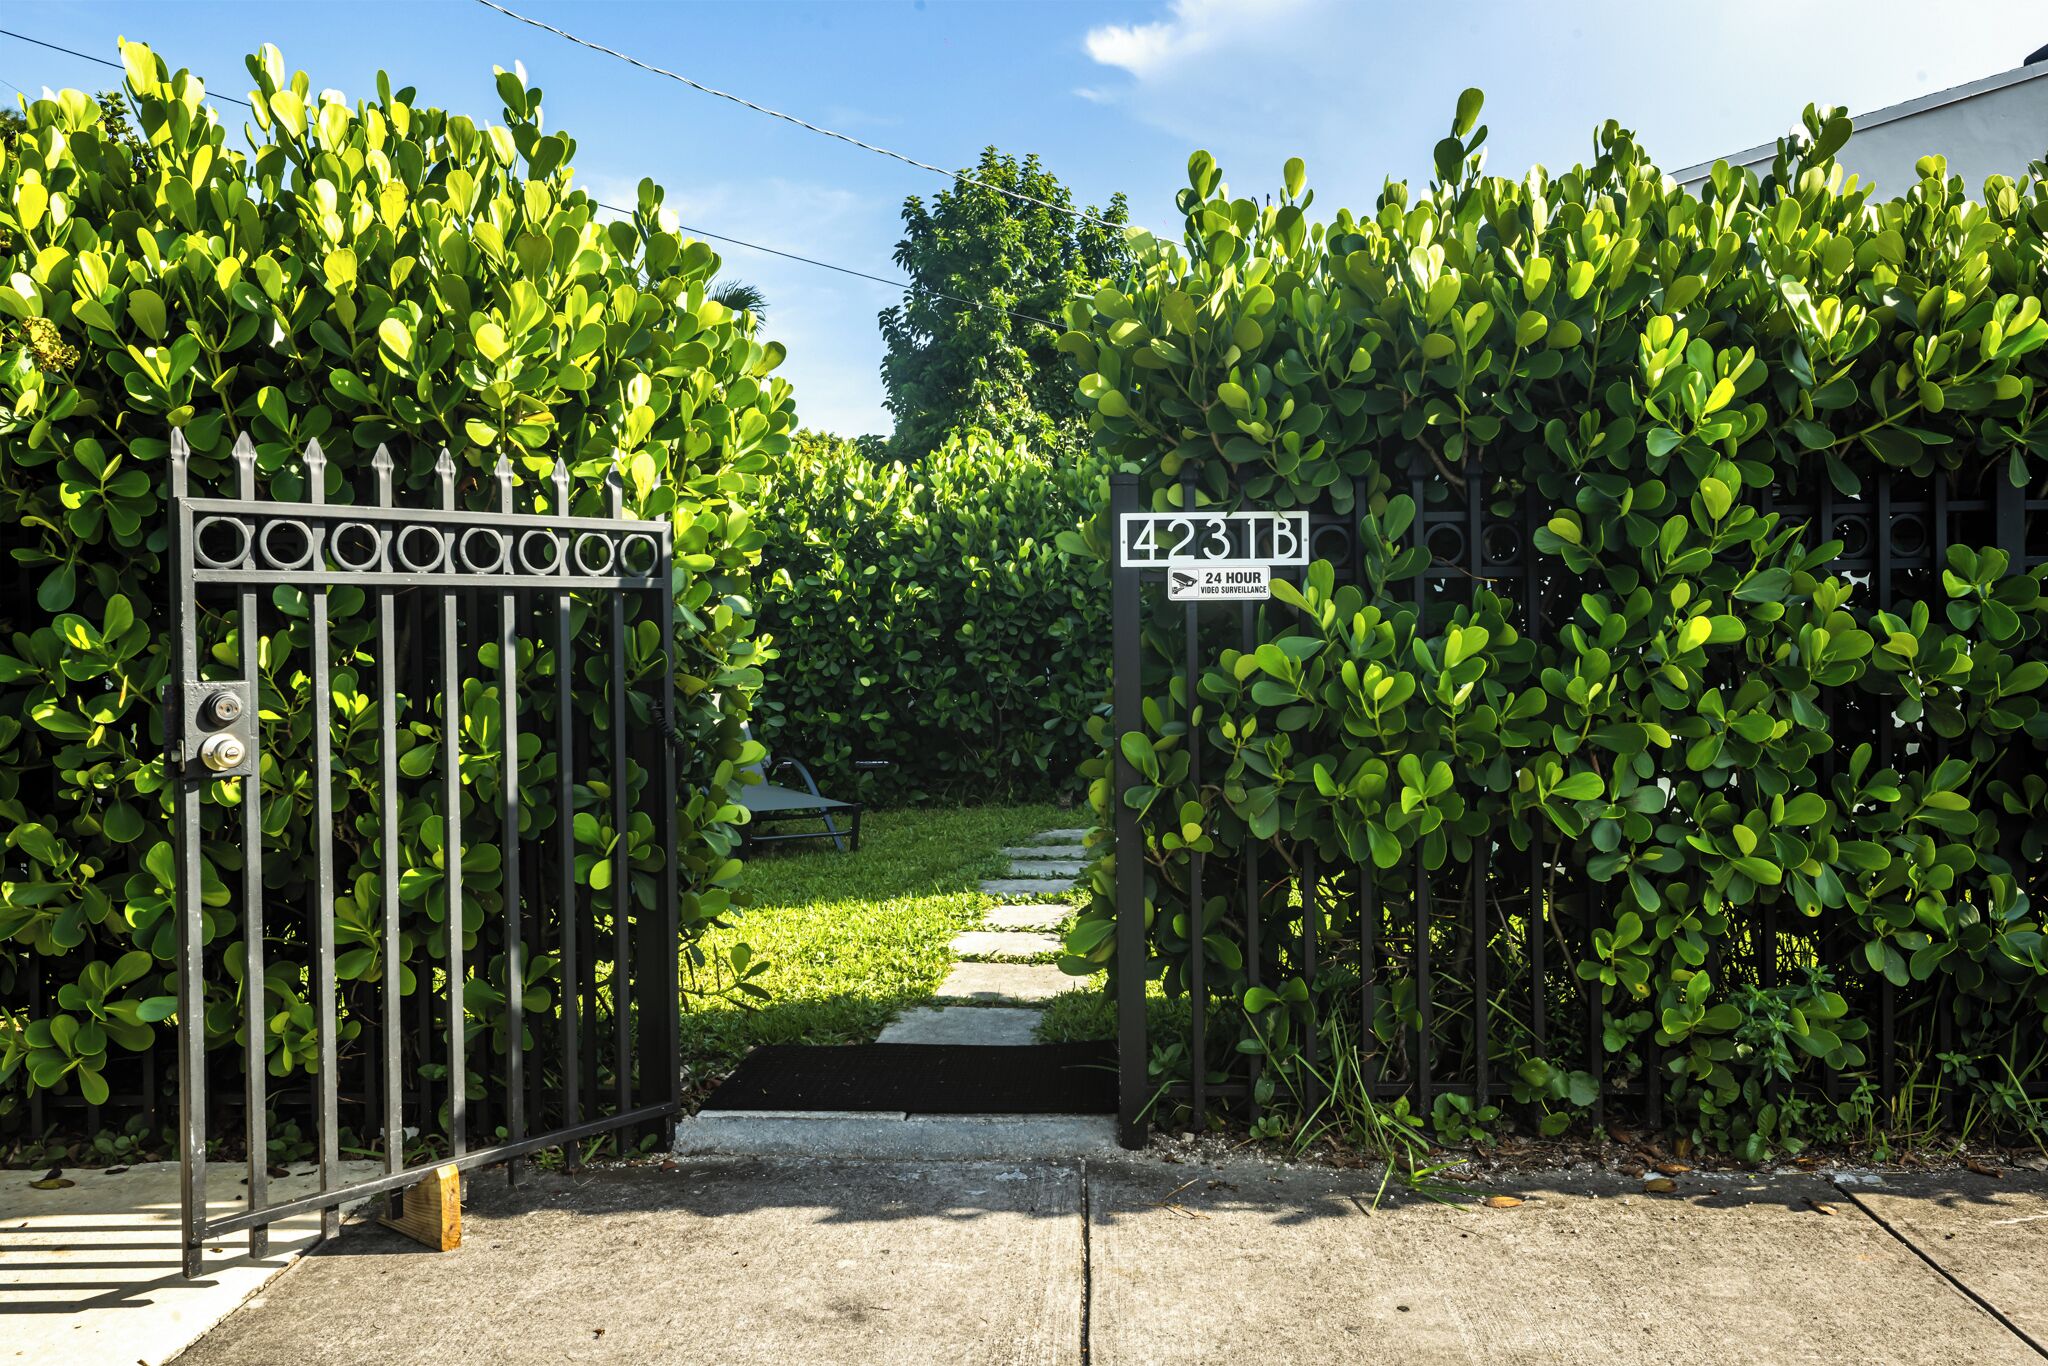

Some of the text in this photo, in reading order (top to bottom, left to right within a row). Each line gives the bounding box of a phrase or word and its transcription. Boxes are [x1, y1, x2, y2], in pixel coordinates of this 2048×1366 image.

[1133, 518, 1297, 559] 4231B
[1205, 572, 1261, 583] 24 HOUR
[1200, 585, 1267, 594] VIDEO SURVEILLANCE
